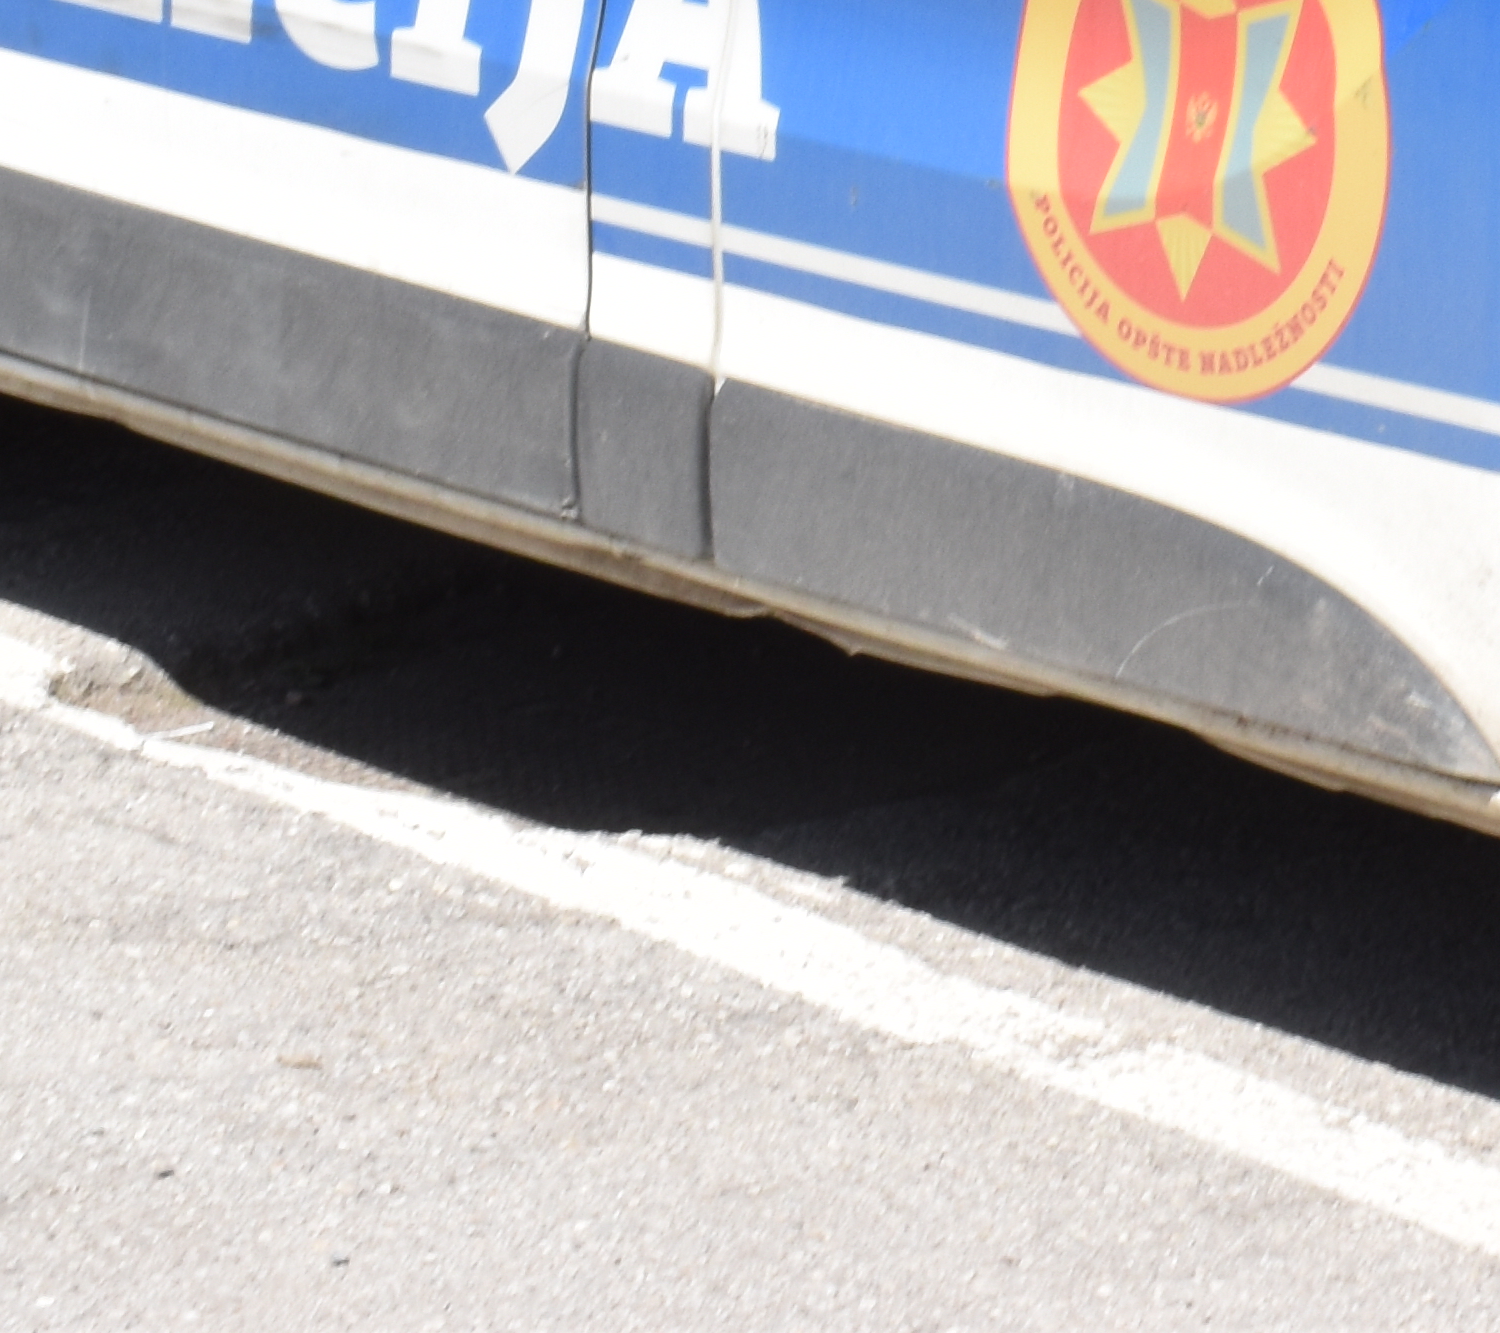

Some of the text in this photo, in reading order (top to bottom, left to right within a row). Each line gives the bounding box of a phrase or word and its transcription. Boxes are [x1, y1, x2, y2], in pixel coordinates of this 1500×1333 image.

[1034, 193, 1346, 376] POLICIJA OPŠTE NADLEŽNOSTI
